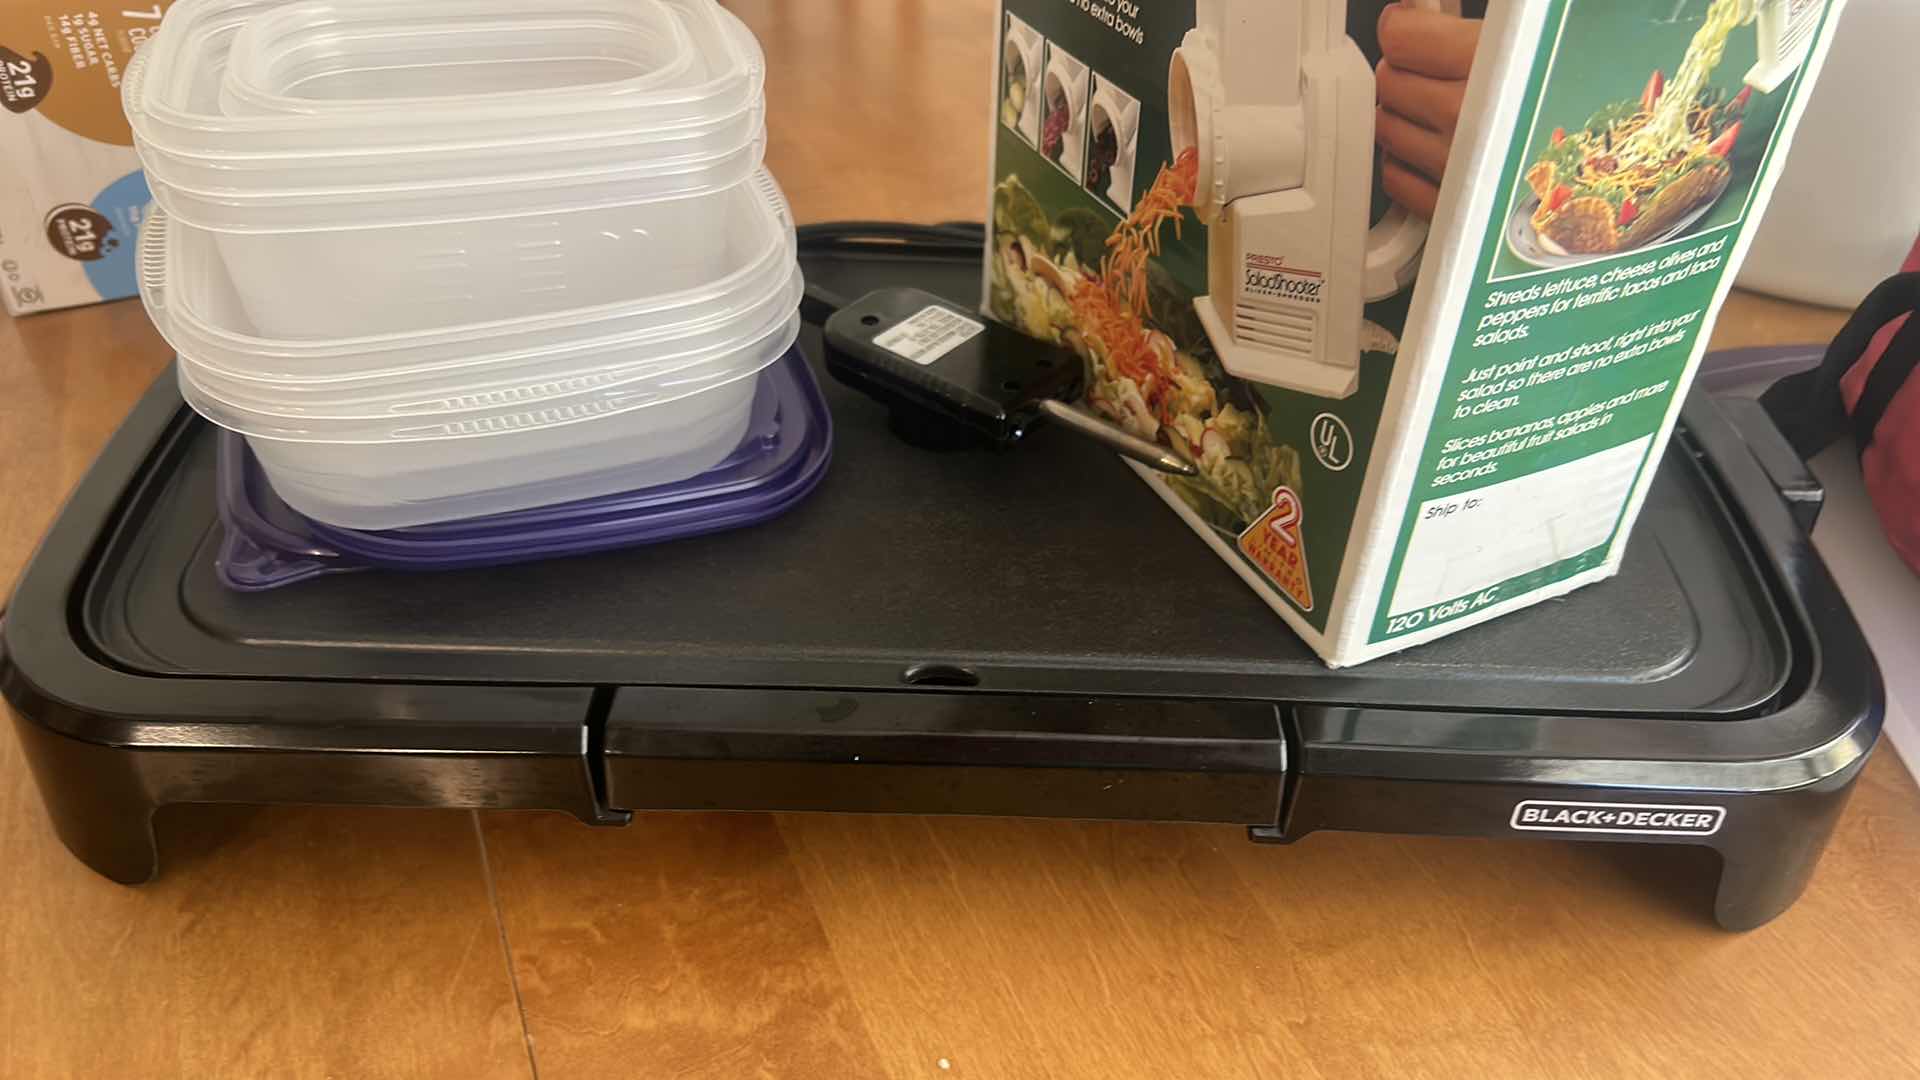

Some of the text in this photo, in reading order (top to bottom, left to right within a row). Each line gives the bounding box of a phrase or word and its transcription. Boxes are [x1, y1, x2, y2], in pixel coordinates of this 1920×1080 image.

[94, 28, 109, 49] NET
[1090, 3, 1114, 26] extra
[1115, 16, 1144, 44] bowls
[66, 36, 87, 70] FIBER
[78, 27, 99, 66] SUGAR
[6, 61, 37, 98] 21g
[101, 52, 121, 88] CARBS
[68, 218, 96, 253] 21g
[1484, 285, 1542, 308] Shreds
[1658, 250, 1699, 270] olives
[1697, 235, 1728, 258] and
[1477, 255, 1721, 331] peppers for terrific tacos and taco
[1457, 327, 1687, 401] salad so there are no extra bowls
[1462, 366, 1497, 384] Just
[1493, 354, 1540, 380] point
[1538, 345, 1574, 367] and
[1614, 326, 1649, 349] right
[1645, 320, 1671, 338] into
[1669, 309, 1702, 332] your
[1441, 434, 1488, 454] Slices
[1557, 401, 1608, 426] apples
[1606, 388, 1638, 410] and
[1633, 380, 1670, 401] more
[1452, 405, 1472, 420] to
[1320, 419, 1341, 464] UL
[1436, 412, 1615, 471] for beautiful fruit salads in
[1271, 491, 1297, 546] 2
[1424, 497, 1484, 520] Ship to:
[1386, 587, 1500, 635] 120 Volts AC
[1521, 807, 1715, 828] BLACK+DECKER
